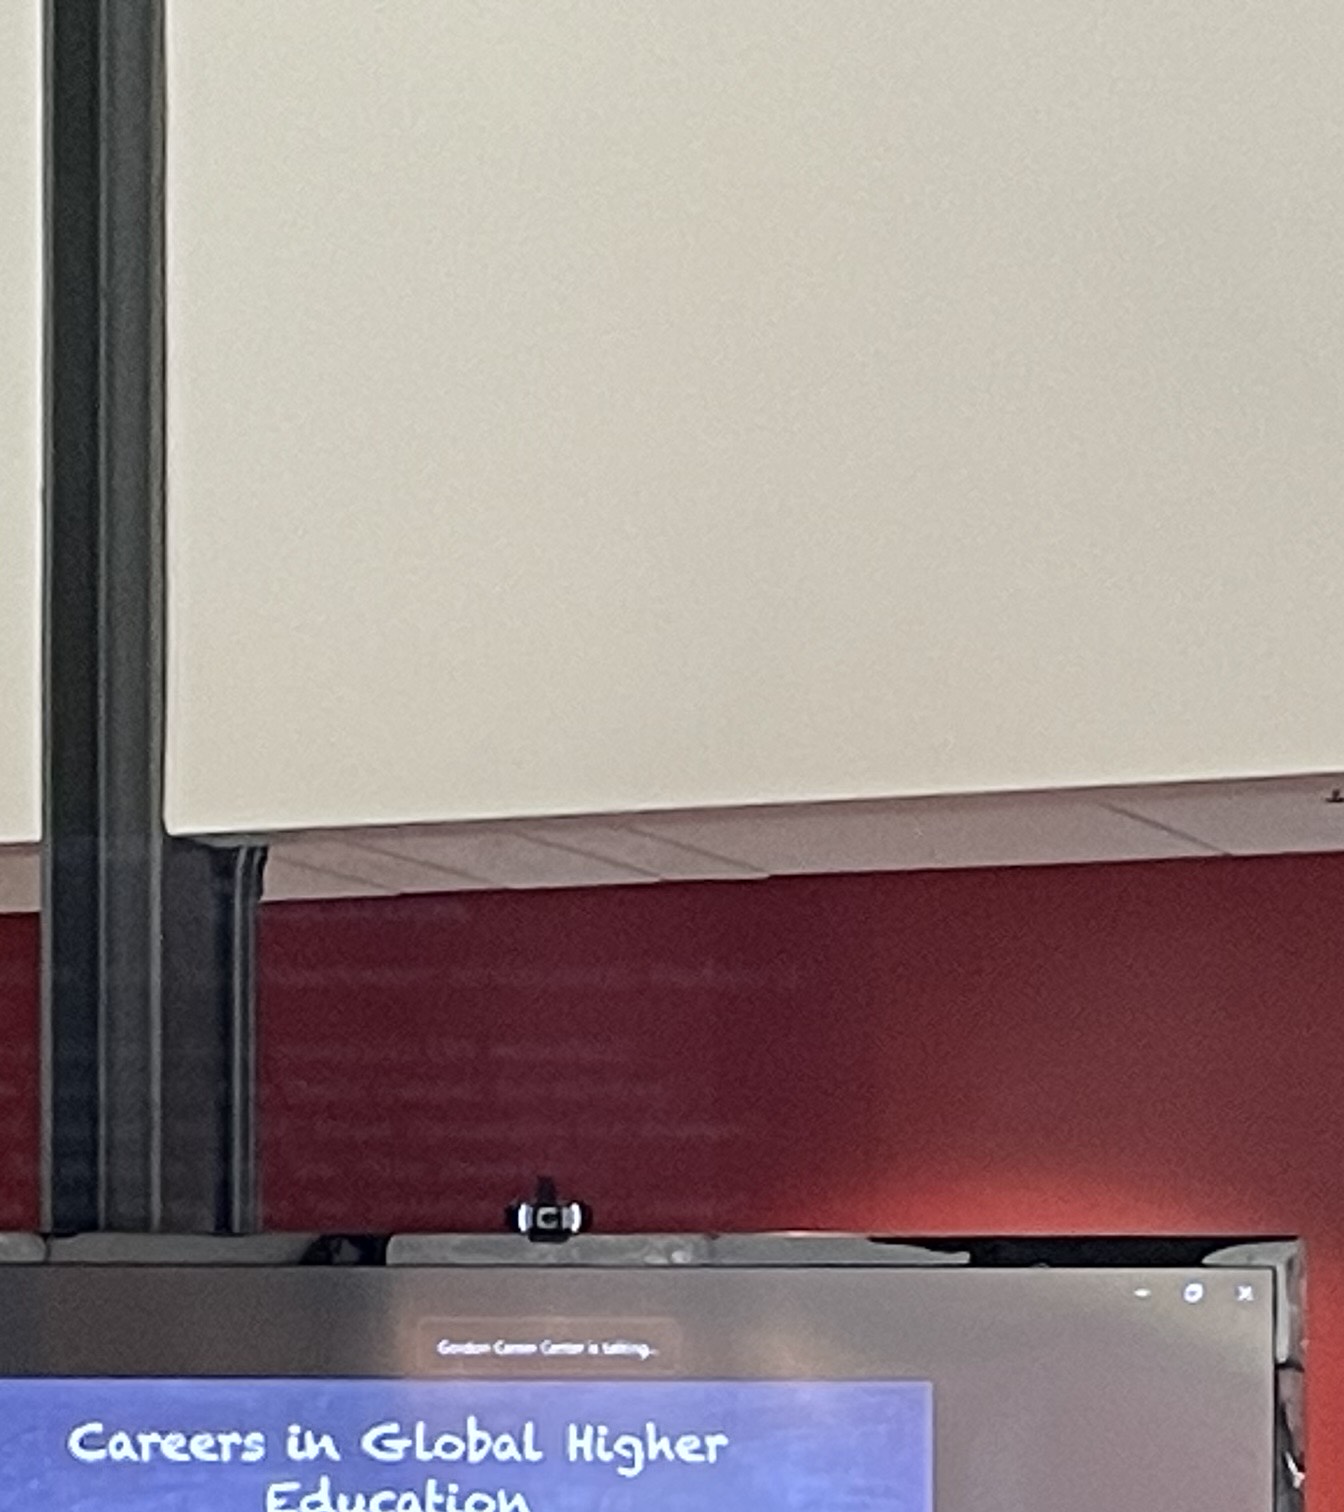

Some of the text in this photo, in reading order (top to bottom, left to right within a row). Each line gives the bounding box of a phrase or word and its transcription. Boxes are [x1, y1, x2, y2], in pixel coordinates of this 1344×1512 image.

[67, 1415, 729, 1478] Careers in Global Higher
